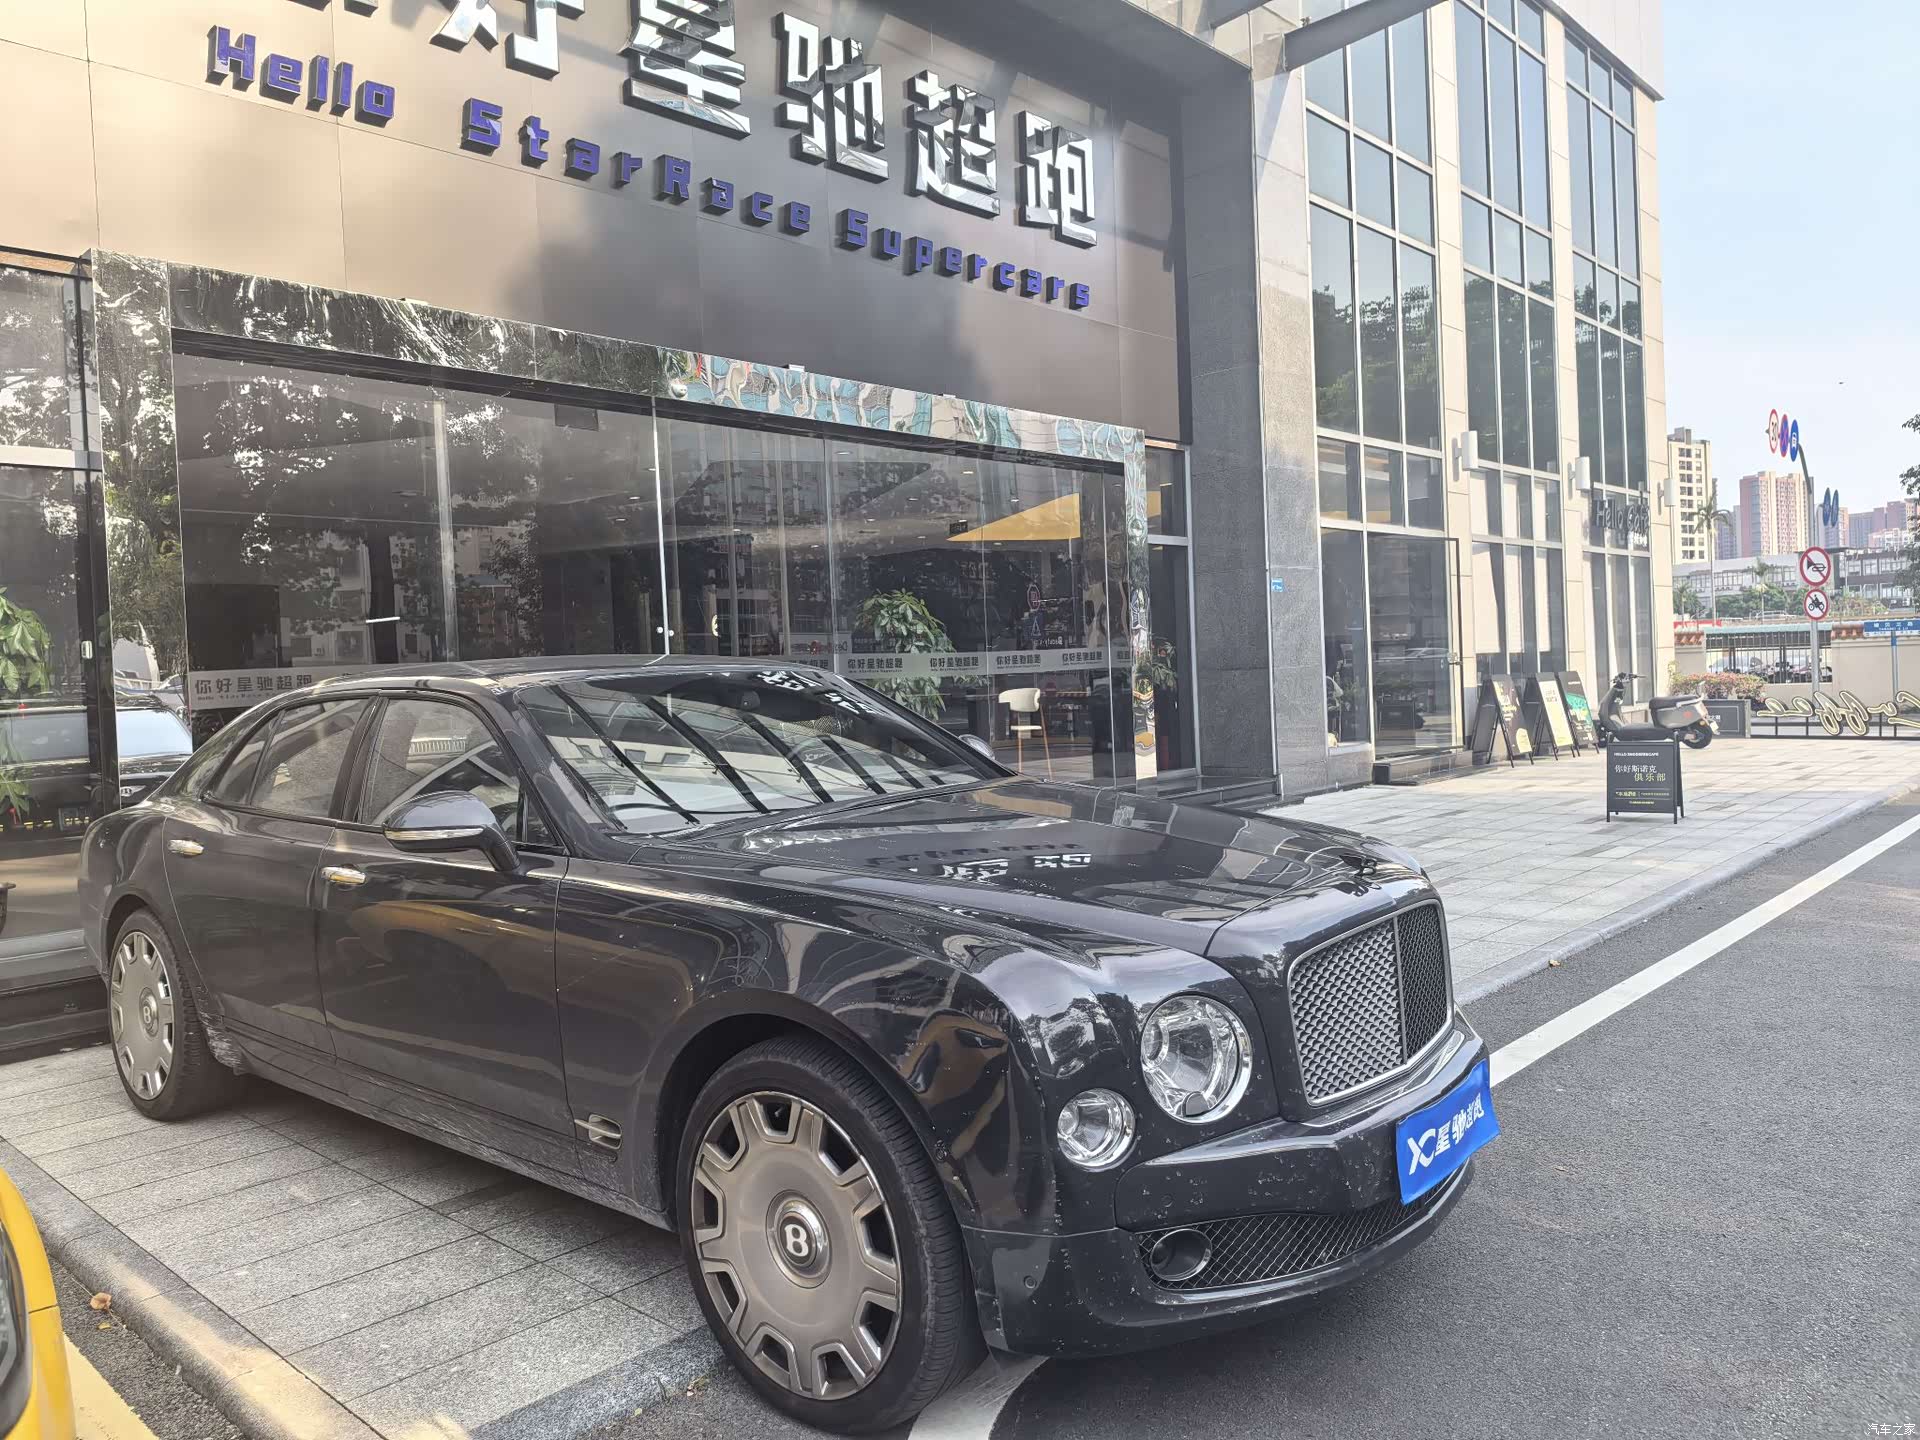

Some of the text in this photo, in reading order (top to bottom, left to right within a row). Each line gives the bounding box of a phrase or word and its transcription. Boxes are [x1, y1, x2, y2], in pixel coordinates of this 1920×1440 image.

[290, 0, 1098, 248] 星驰超跑
[207, 25, 1090, 310] Hello StarRace Supercars
[1596, 499, 1624, 530] Hello
[194, 674, 313, 694] 你好星驰超跑
[784, 1223, 809, 1257] B
